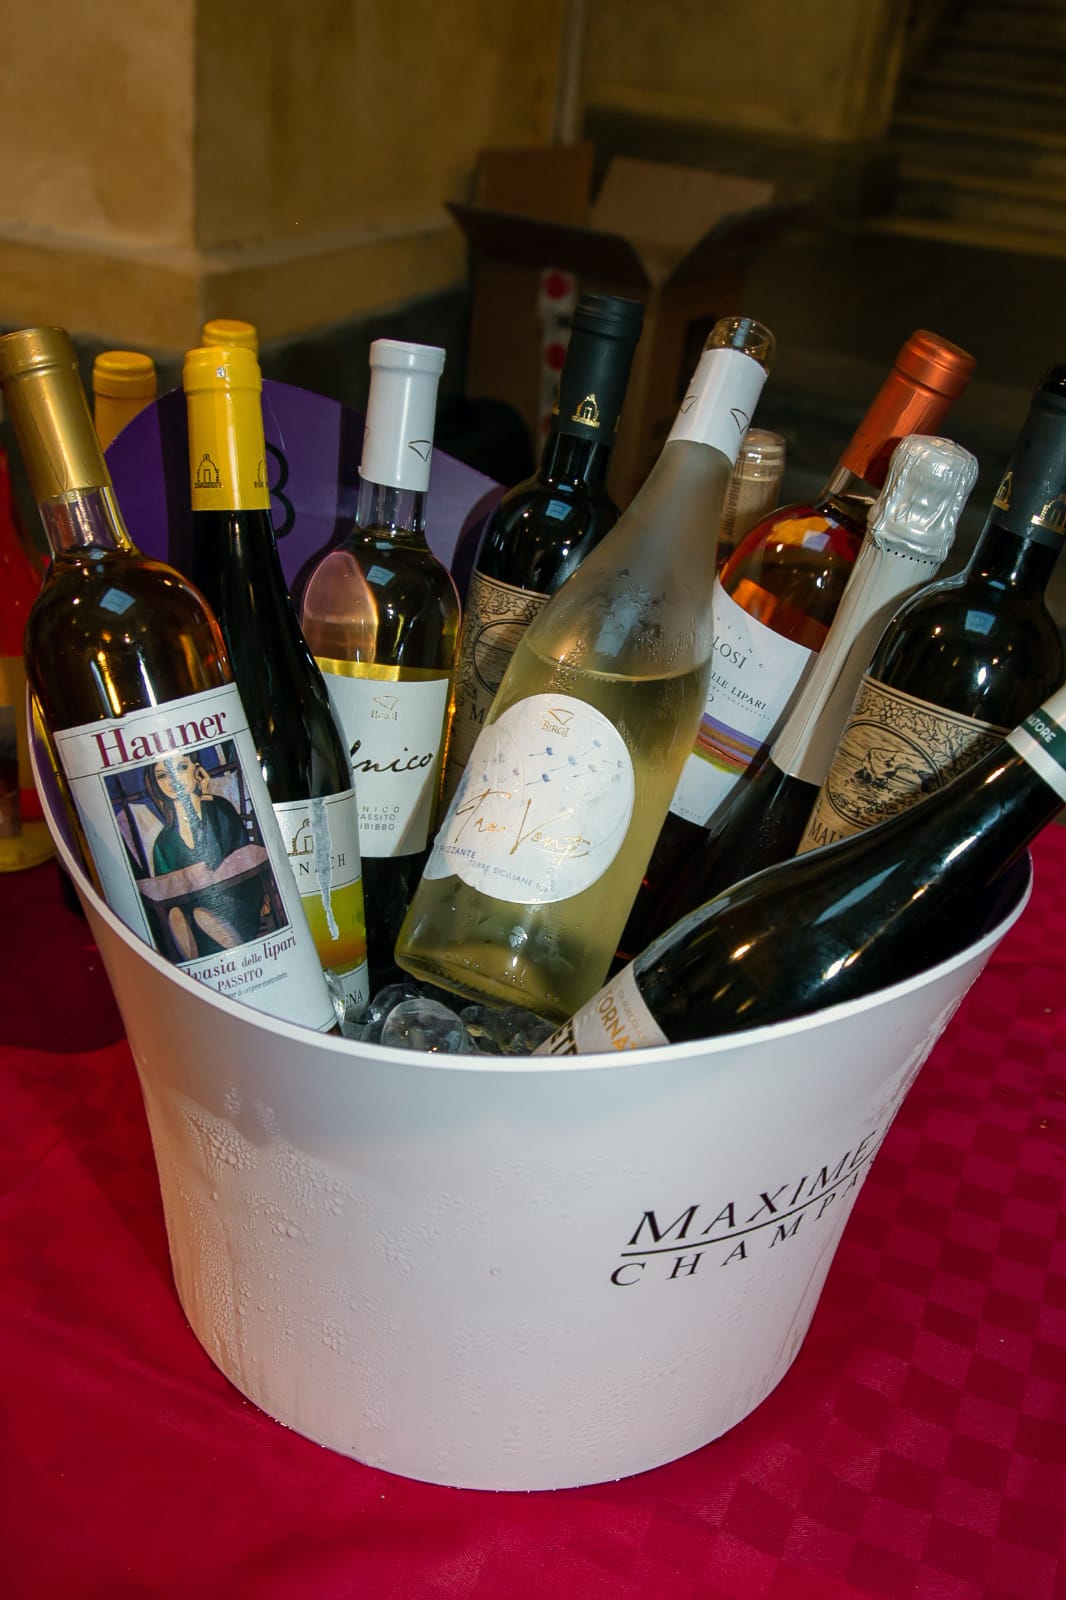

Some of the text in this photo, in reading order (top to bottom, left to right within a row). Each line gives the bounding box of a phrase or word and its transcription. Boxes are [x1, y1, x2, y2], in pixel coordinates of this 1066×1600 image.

[712, 635, 747, 669] LOSI
[711, 672, 729, 689] LLE
[730, 686, 767, 710] LIPARI
[91, 711, 227, 768] Hauner
[350, 739, 434, 773] nico
[359, 813, 397, 822] ASSITO
[359, 821, 396, 831] IBIBBO
[362, 805, 401, 814] NICO
[492, 866, 533, 887] SICILIANE
[187, 930, 297, 981] lvasia delle lipari
[217, 967, 264, 992] PASSITO
[597, 986, 638, 1051] TORNA
[627, 1129, 877, 1246] MAXIME
[610, 1169, 860, 1286] CHAMPA
